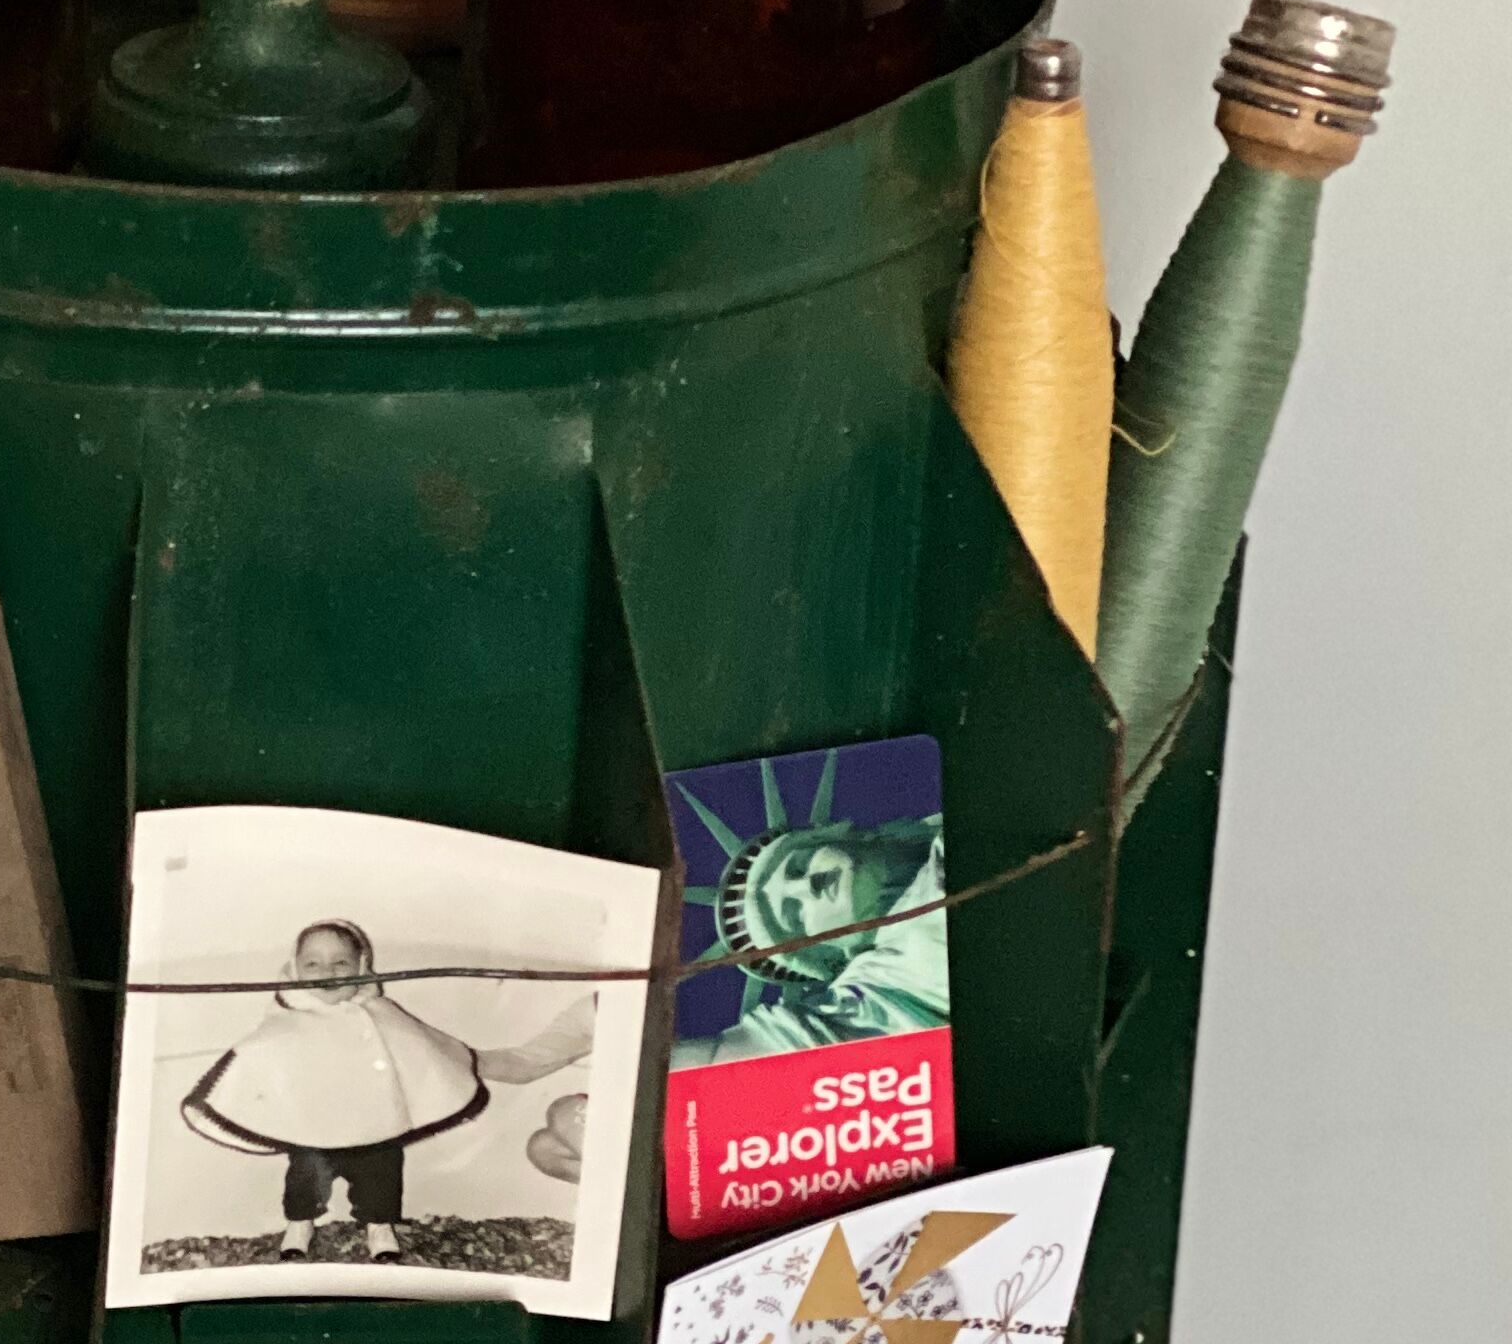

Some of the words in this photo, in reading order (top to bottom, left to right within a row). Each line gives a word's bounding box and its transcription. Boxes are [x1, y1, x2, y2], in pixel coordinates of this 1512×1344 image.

[718, 1108, 933, 1175] Explorer
[790, 1166, 861, 1201] York
[865, 1152, 934, 1187] New
[721, 1179, 784, 1210] City
